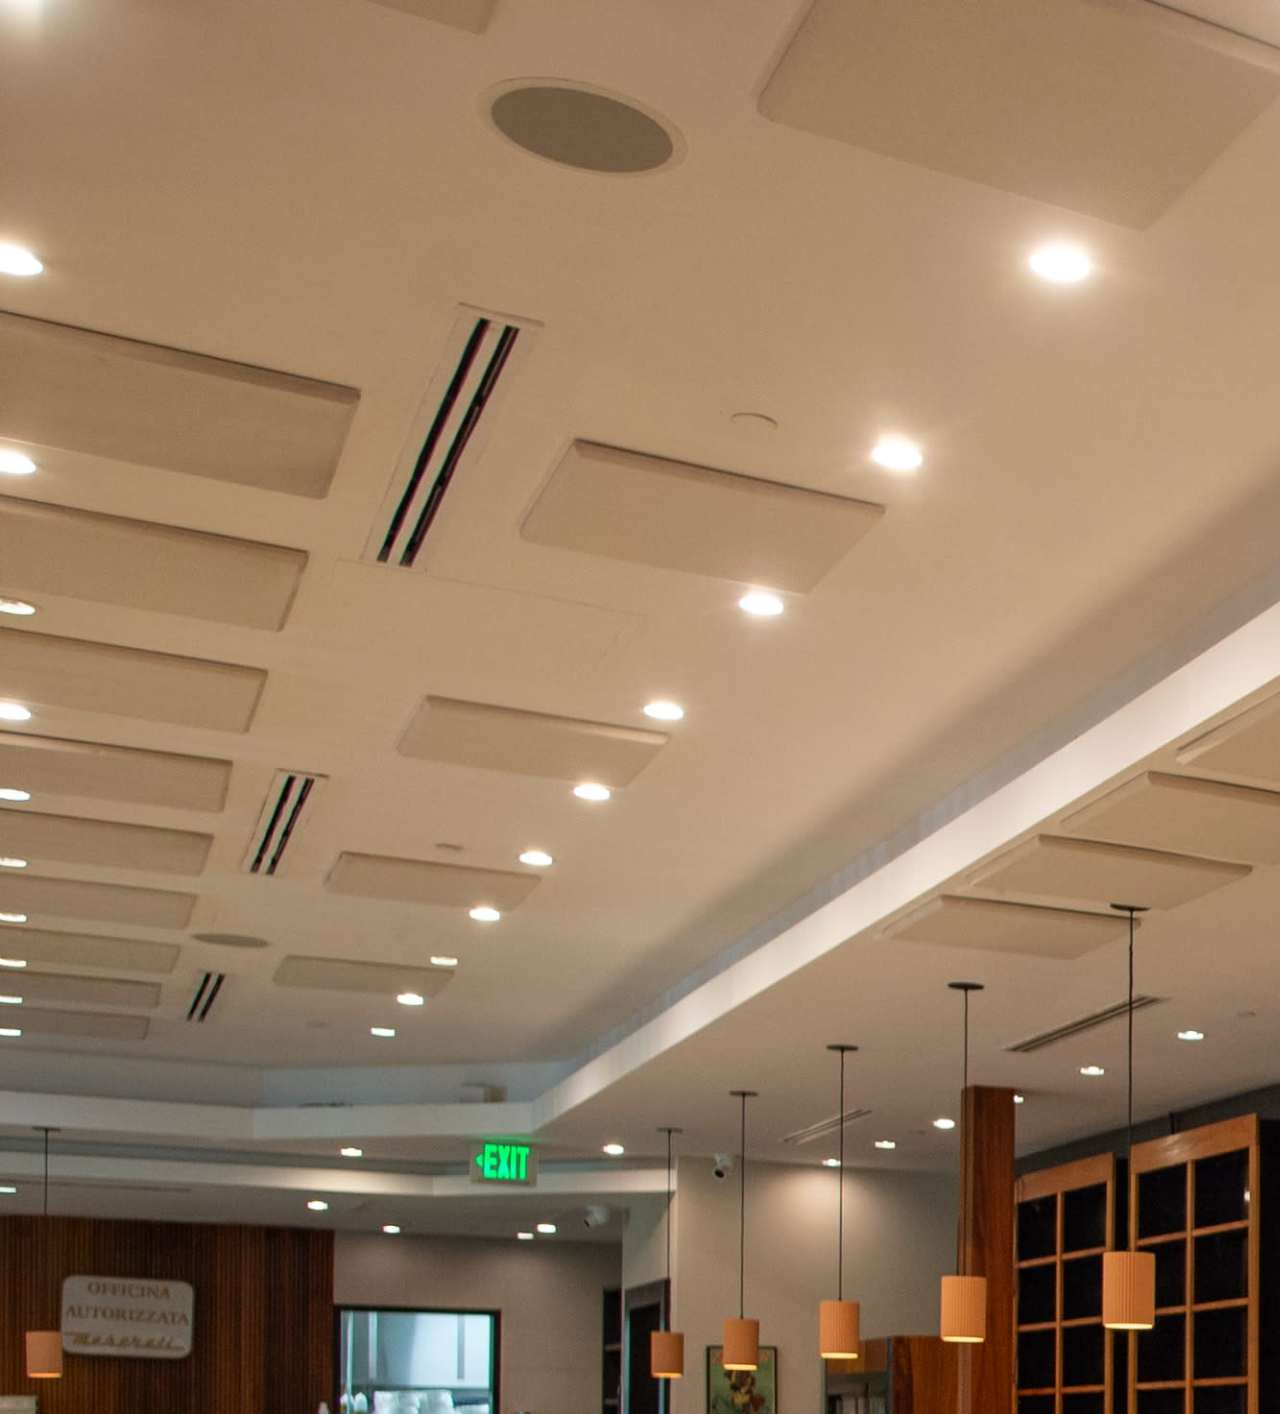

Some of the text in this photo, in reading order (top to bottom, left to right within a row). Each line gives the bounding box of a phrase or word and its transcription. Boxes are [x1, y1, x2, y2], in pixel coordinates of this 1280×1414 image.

[484, 1143, 529, 1180] EXIT
[87, 1281, 170, 1298] OFFICINA
[65, 1304, 189, 1326] AUTORIZZATA
